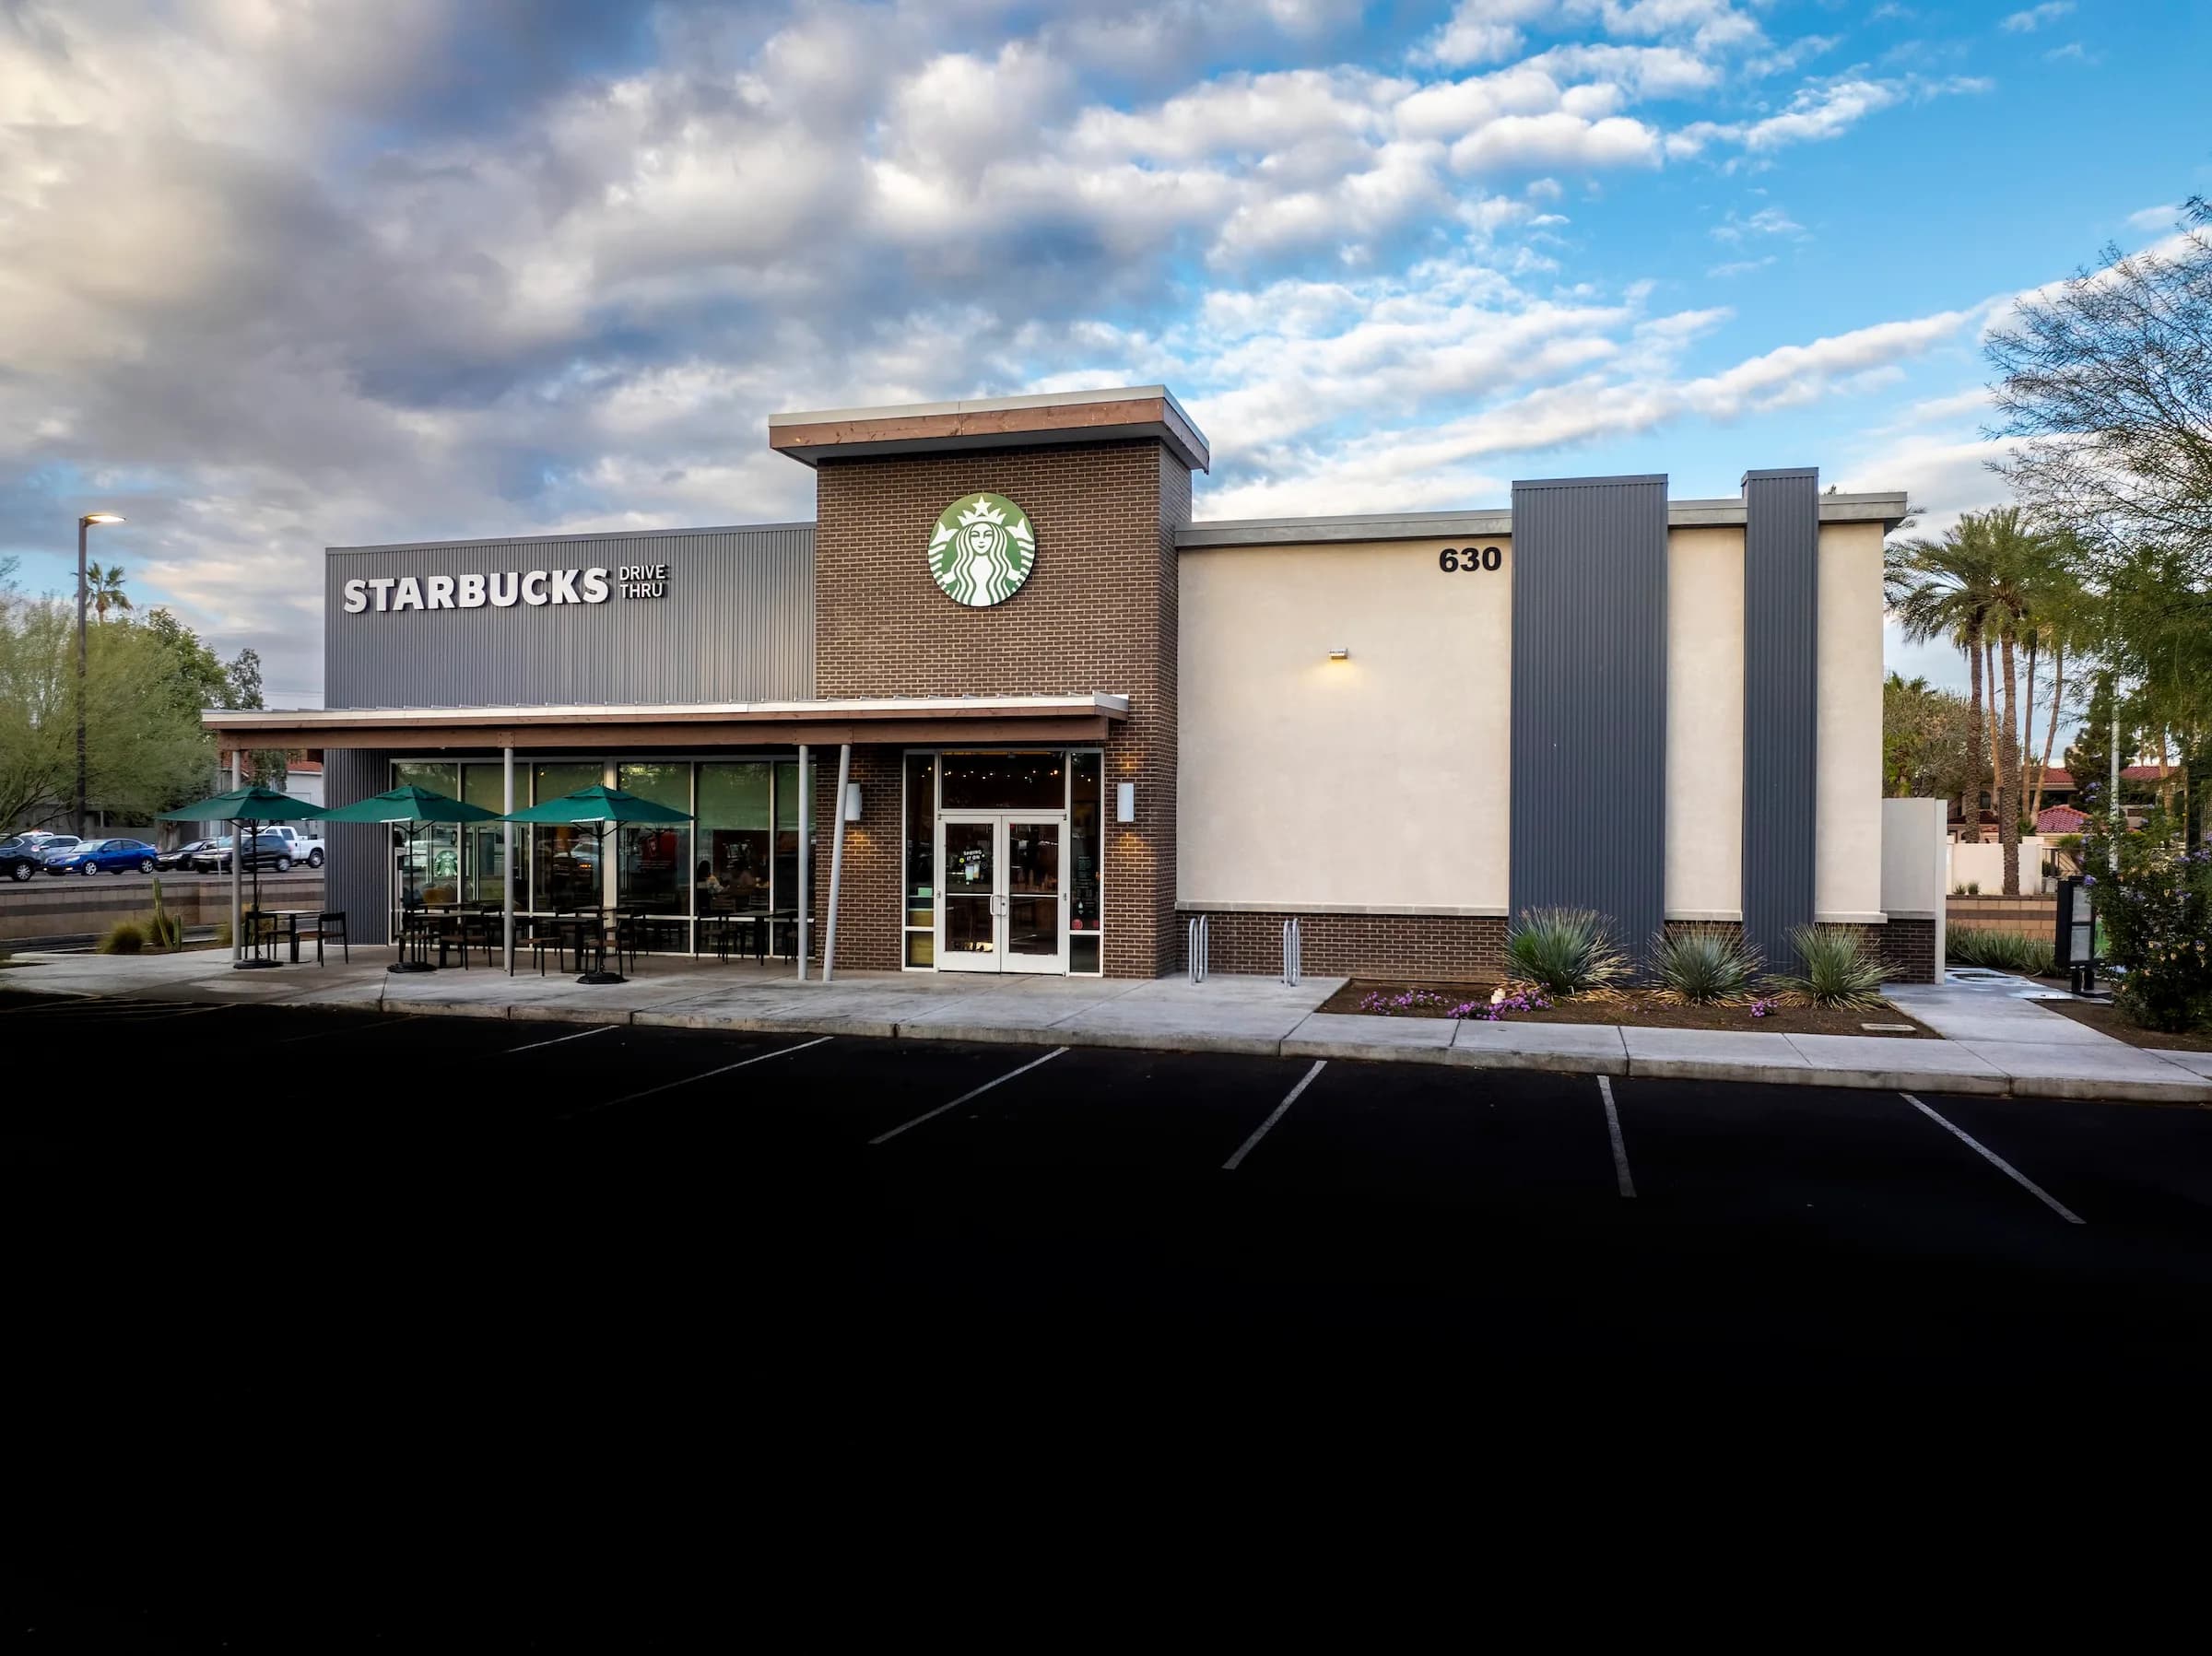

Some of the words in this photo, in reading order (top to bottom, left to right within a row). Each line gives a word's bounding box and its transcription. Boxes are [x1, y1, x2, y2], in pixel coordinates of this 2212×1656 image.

[1440, 546, 1501, 572] 630
[619, 564, 666, 581] DRIVE
[344, 567, 610, 614] STARBUCKS
[620, 582, 664, 599] THRU
